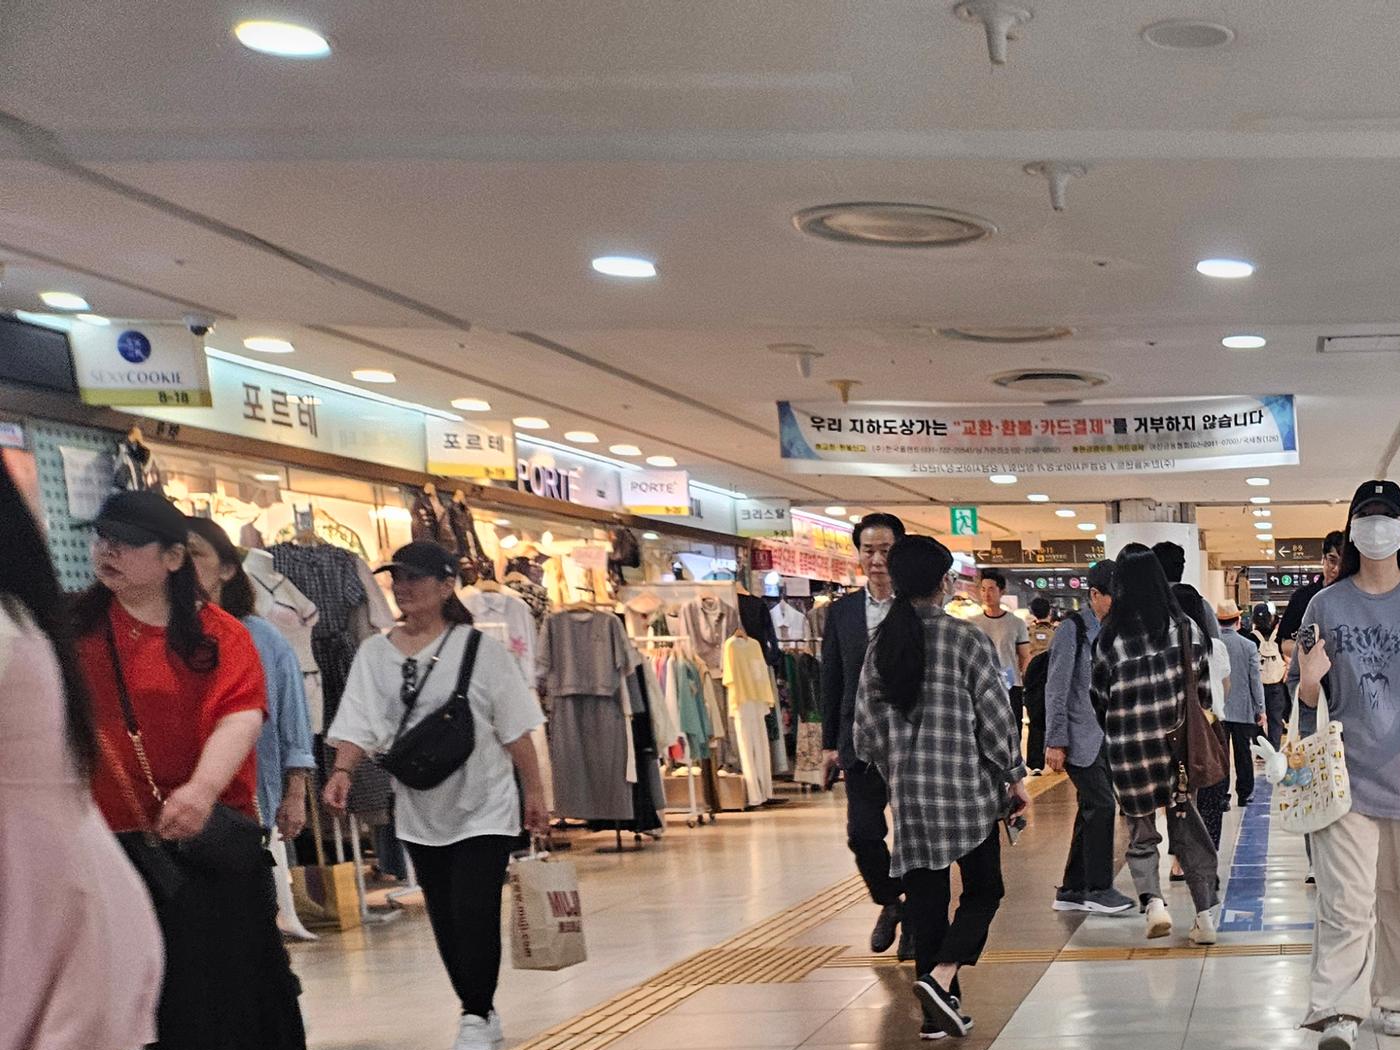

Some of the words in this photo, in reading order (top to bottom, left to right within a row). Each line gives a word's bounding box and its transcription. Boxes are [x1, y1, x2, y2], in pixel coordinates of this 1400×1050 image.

[242, 382, 318, 438] 포르테
[810, 416, 842, 433] 우리
[849, 418, 948, 437] 지하도상가는
[1134, 415, 1196, 434] 거부하지
[1202, 409, 1264, 430] 않습니다
[443, 433, 505, 452] 포르테
[741, 508, 785, 520] 크리스탈
